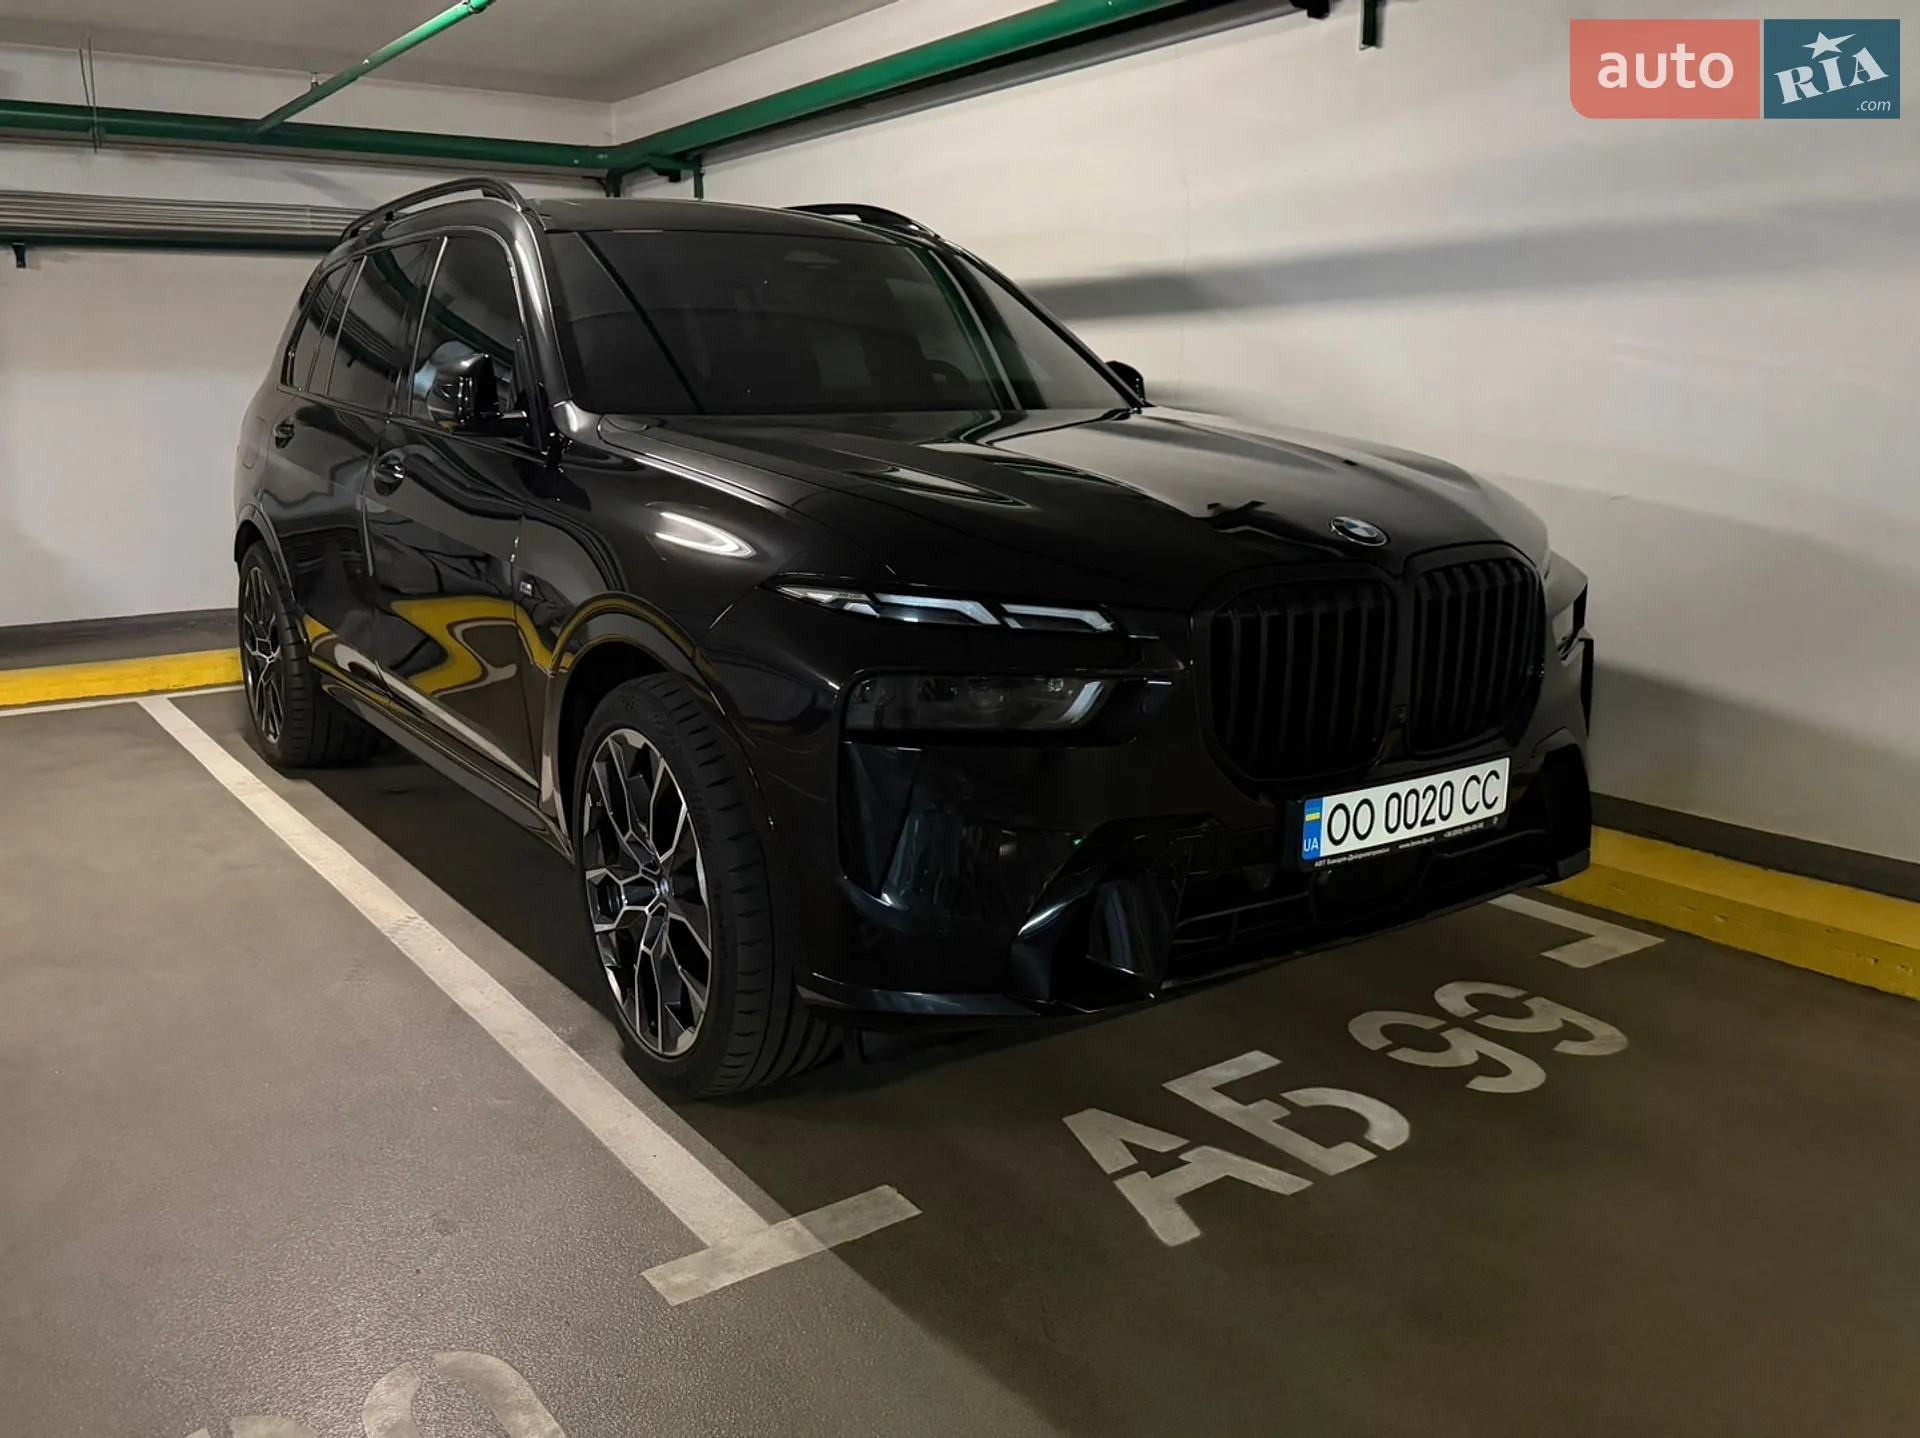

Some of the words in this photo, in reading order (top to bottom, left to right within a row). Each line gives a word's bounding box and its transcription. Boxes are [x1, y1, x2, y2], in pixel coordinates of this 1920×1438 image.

[1303, 837, 1319, 852] UA
[1327, 798, 1375, 846] OO
[1384, 781, 1454, 834] 0020
[1462, 769, 1500, 815] CC
[1348, 980, 1628, 1094] 99
